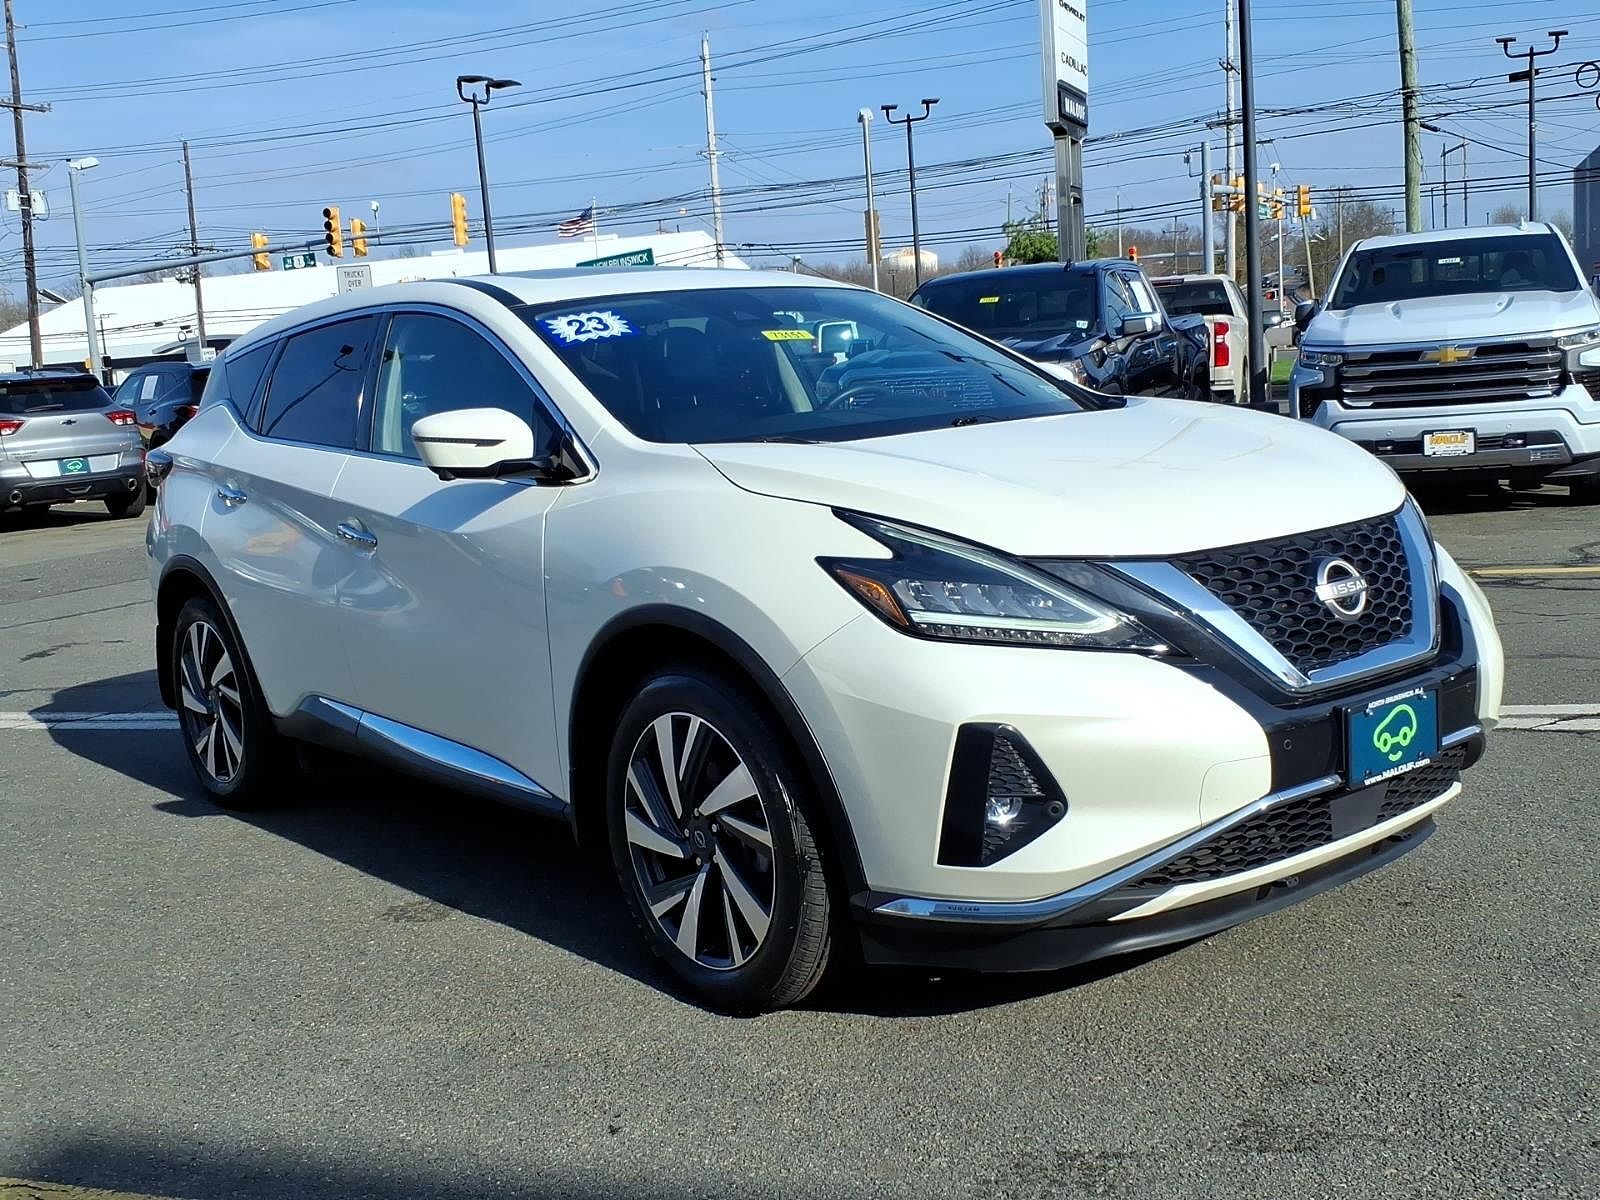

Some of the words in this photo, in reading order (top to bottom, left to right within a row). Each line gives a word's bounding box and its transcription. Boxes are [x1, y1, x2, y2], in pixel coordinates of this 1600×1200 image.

[1061, 52, 1088, 76] CADILLAC
[1065, 97, 1085, 120] MALOUF
[344, 270, 364, 279] TRUCKS
[347, 280, 361, 288] OVER
[566, 316, 611, 336] 23
